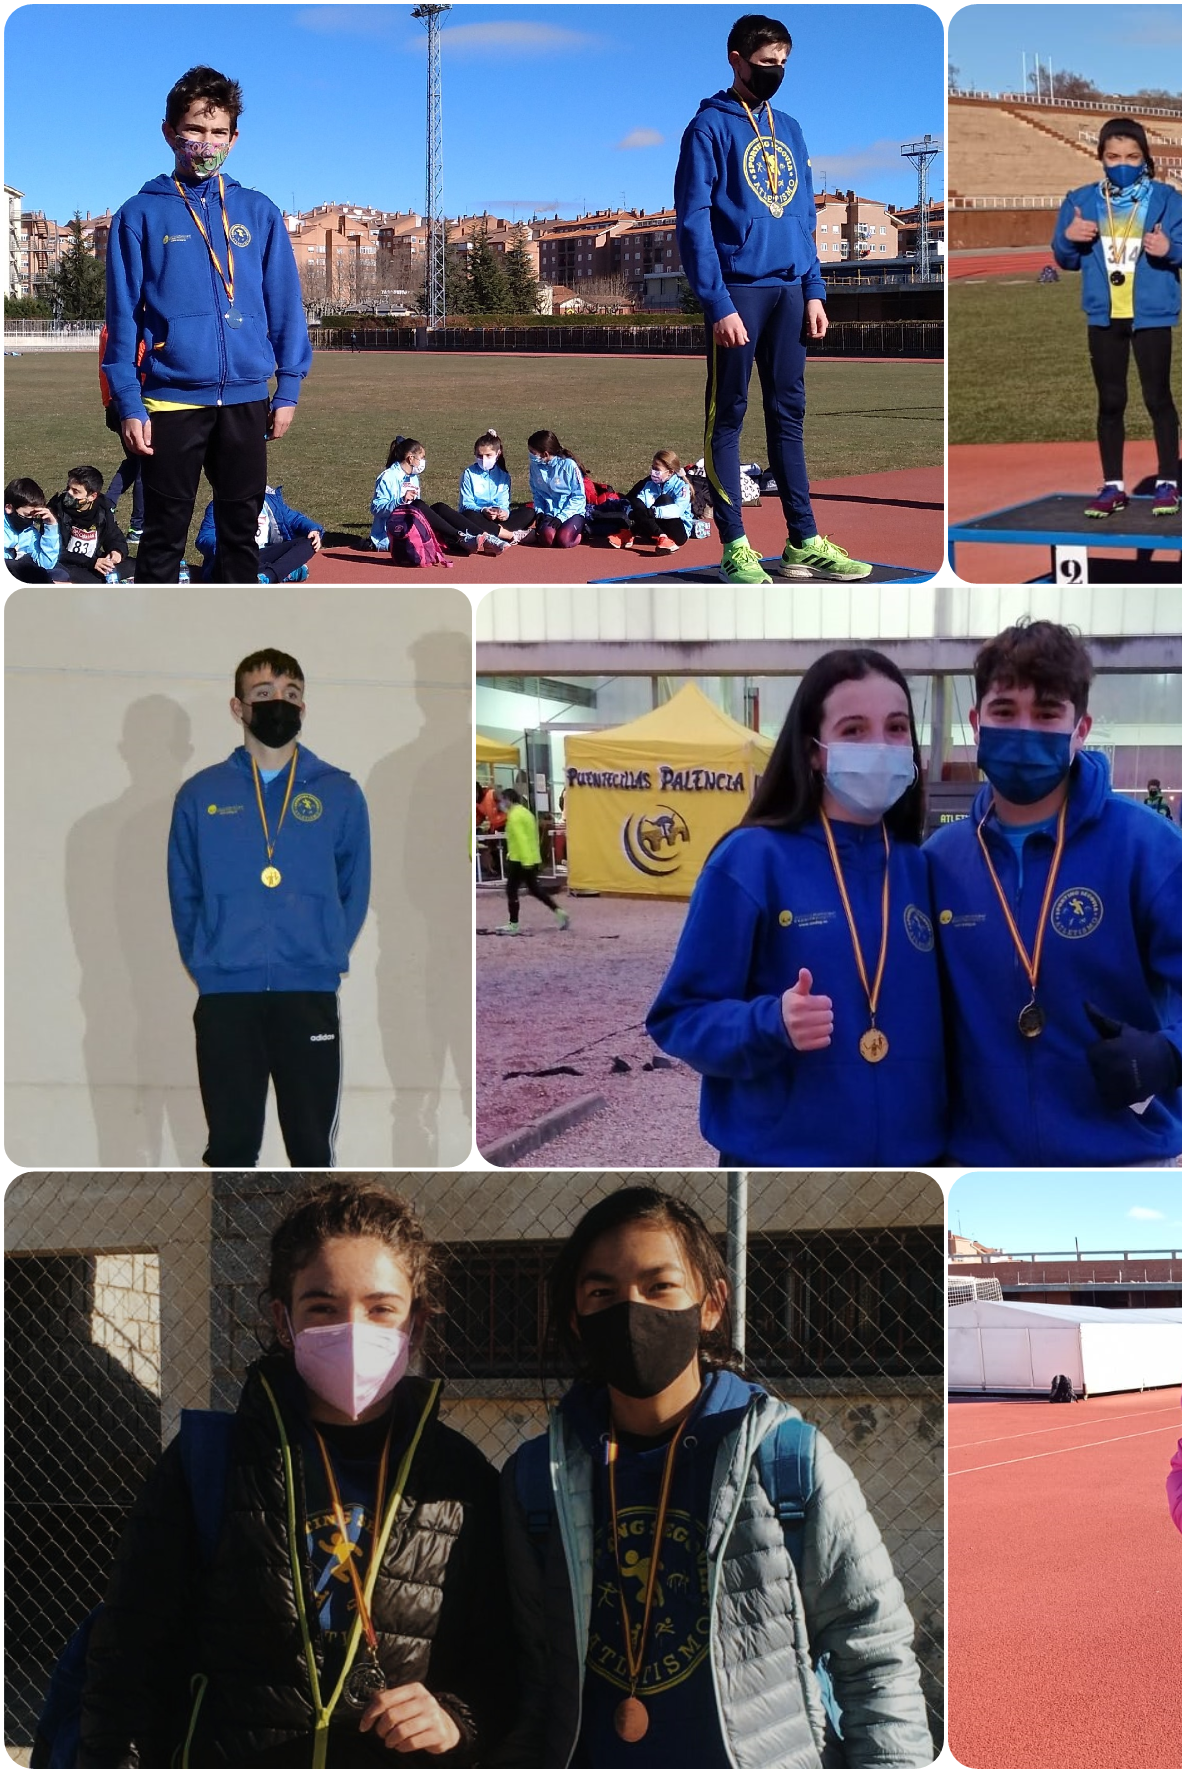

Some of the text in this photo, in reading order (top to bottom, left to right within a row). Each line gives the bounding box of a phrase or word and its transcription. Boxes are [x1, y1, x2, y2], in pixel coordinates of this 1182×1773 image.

[1108, 245, 1139, 265] 314
[72, 541, 90, 554] 83
[1061, 559, 1083, 584] 2
[659, 765, 745, 792] PALENCIA
